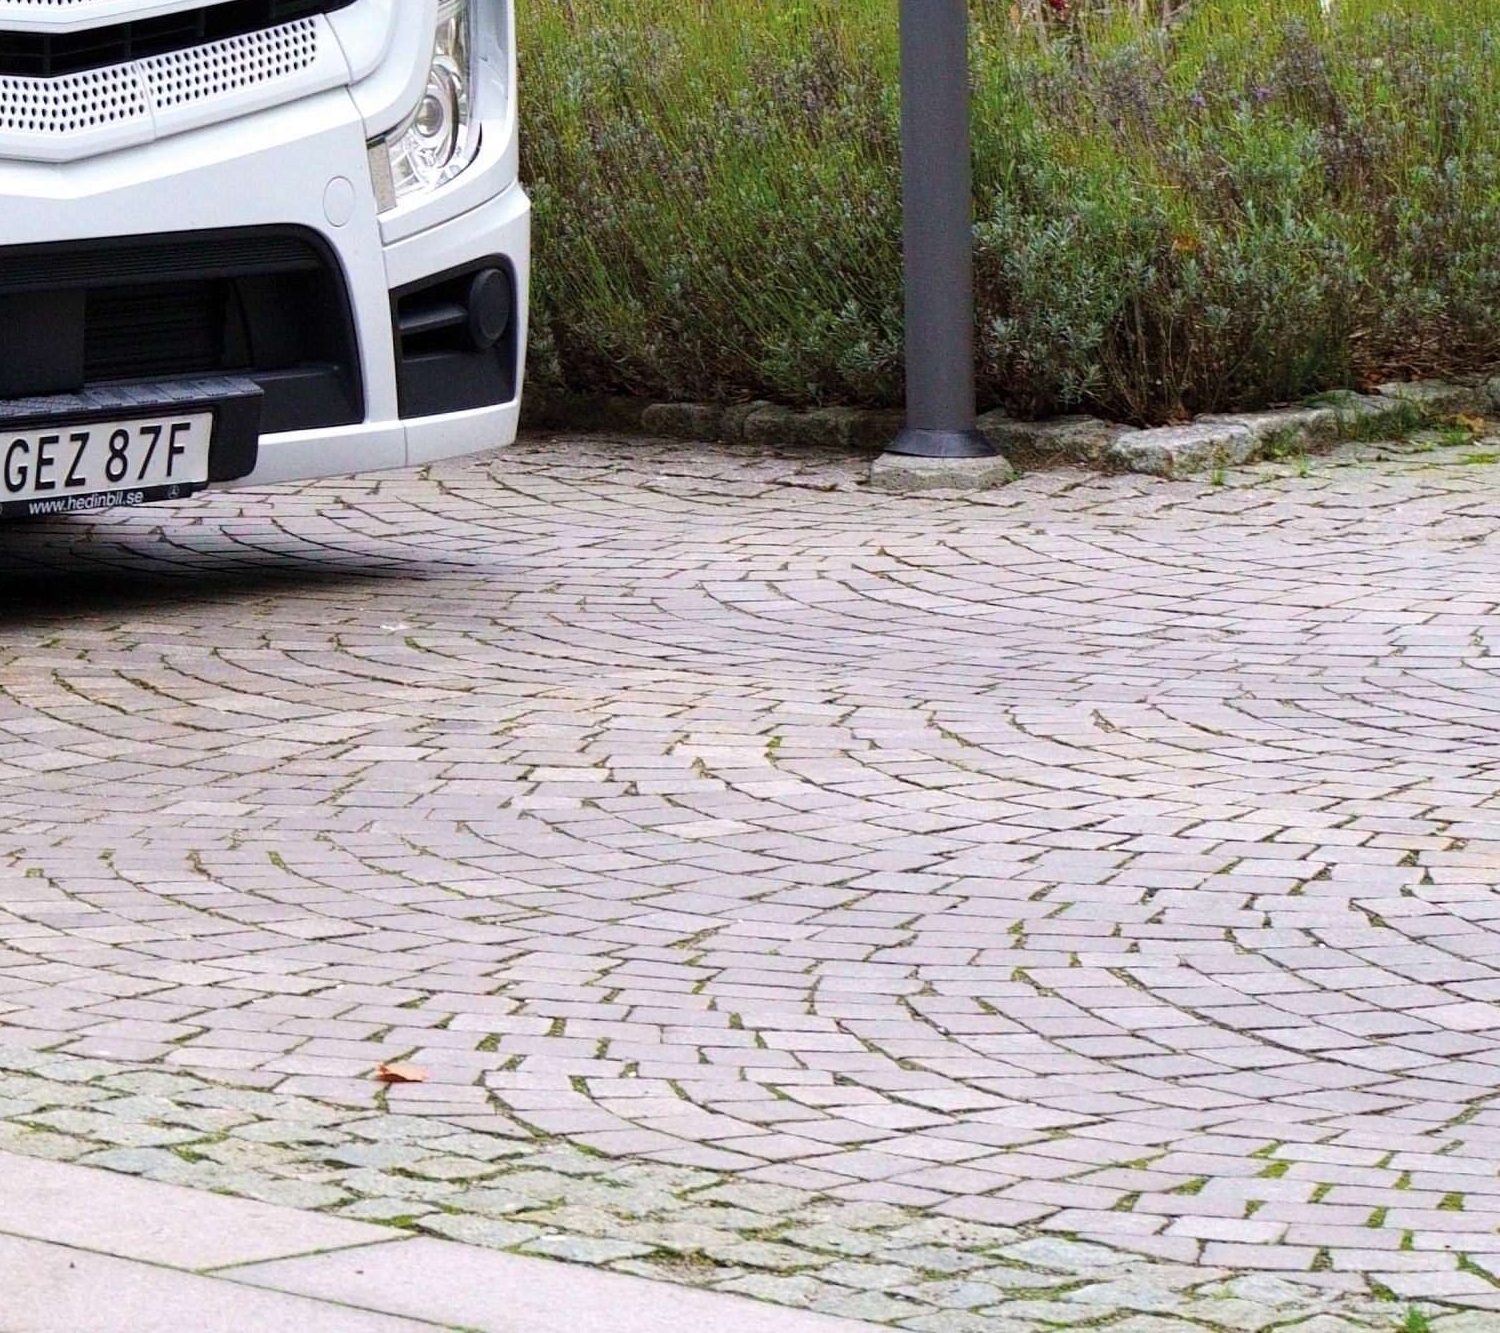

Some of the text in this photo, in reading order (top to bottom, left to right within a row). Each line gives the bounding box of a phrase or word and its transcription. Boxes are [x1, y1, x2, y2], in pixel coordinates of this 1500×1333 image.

[3, 422, 192, 493] GEZ 87F
[28, 490, 144, 515] www.hedinbil.se
